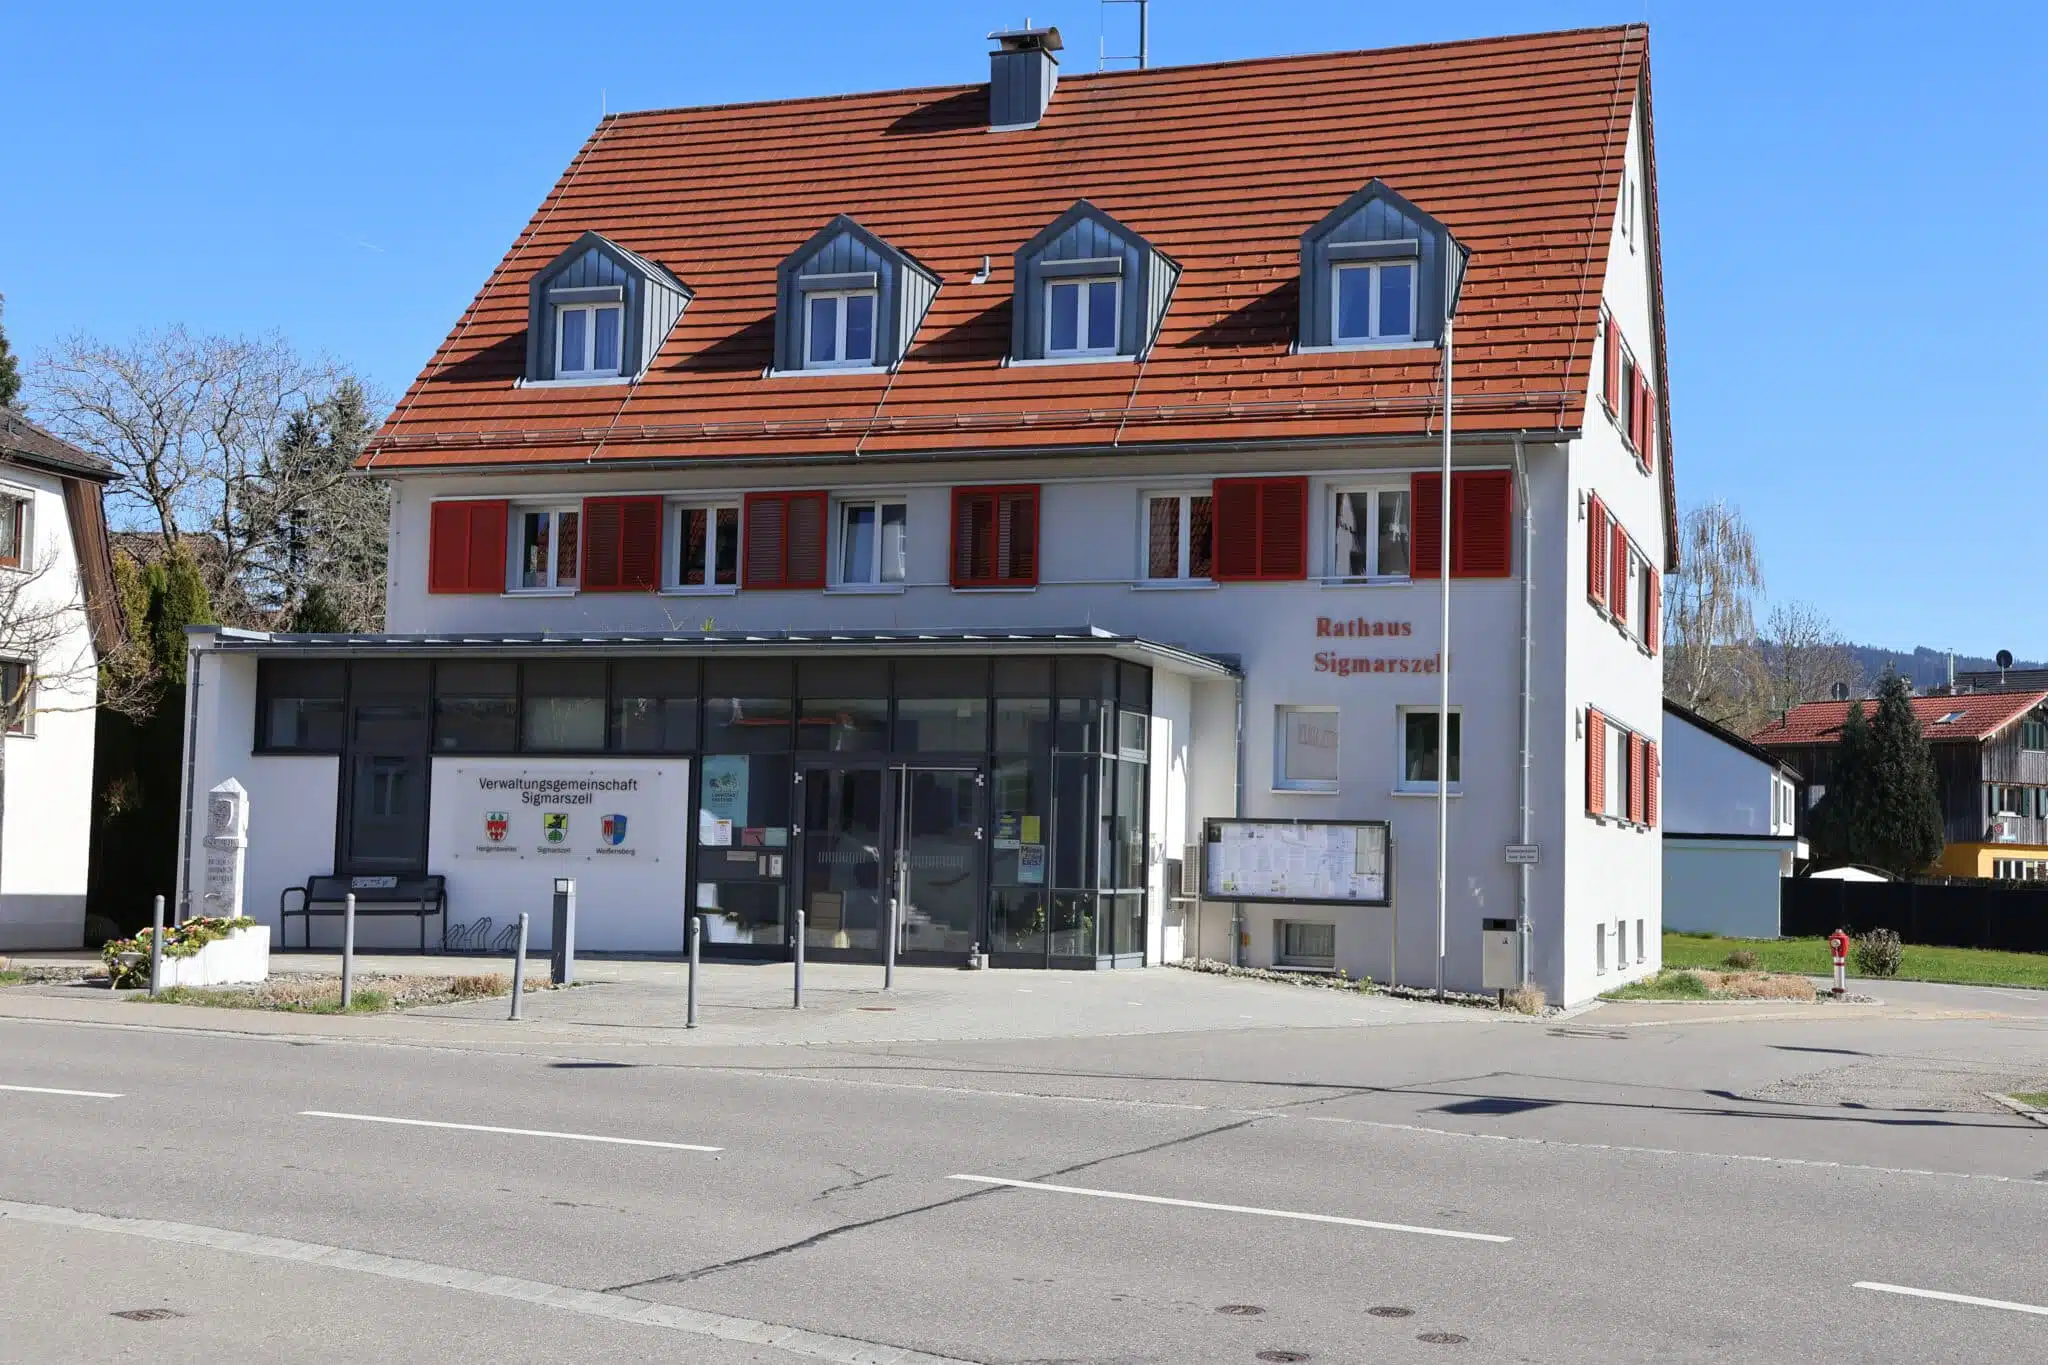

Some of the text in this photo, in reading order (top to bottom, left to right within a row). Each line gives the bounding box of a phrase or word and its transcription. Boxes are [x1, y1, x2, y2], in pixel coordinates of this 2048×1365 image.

[1316, 616, 1412, 637] Rathaus
[478, 777, 638, 792] Verwaltungsgemeinschaft
[521, 792, 593, 806] Sigmarszell
